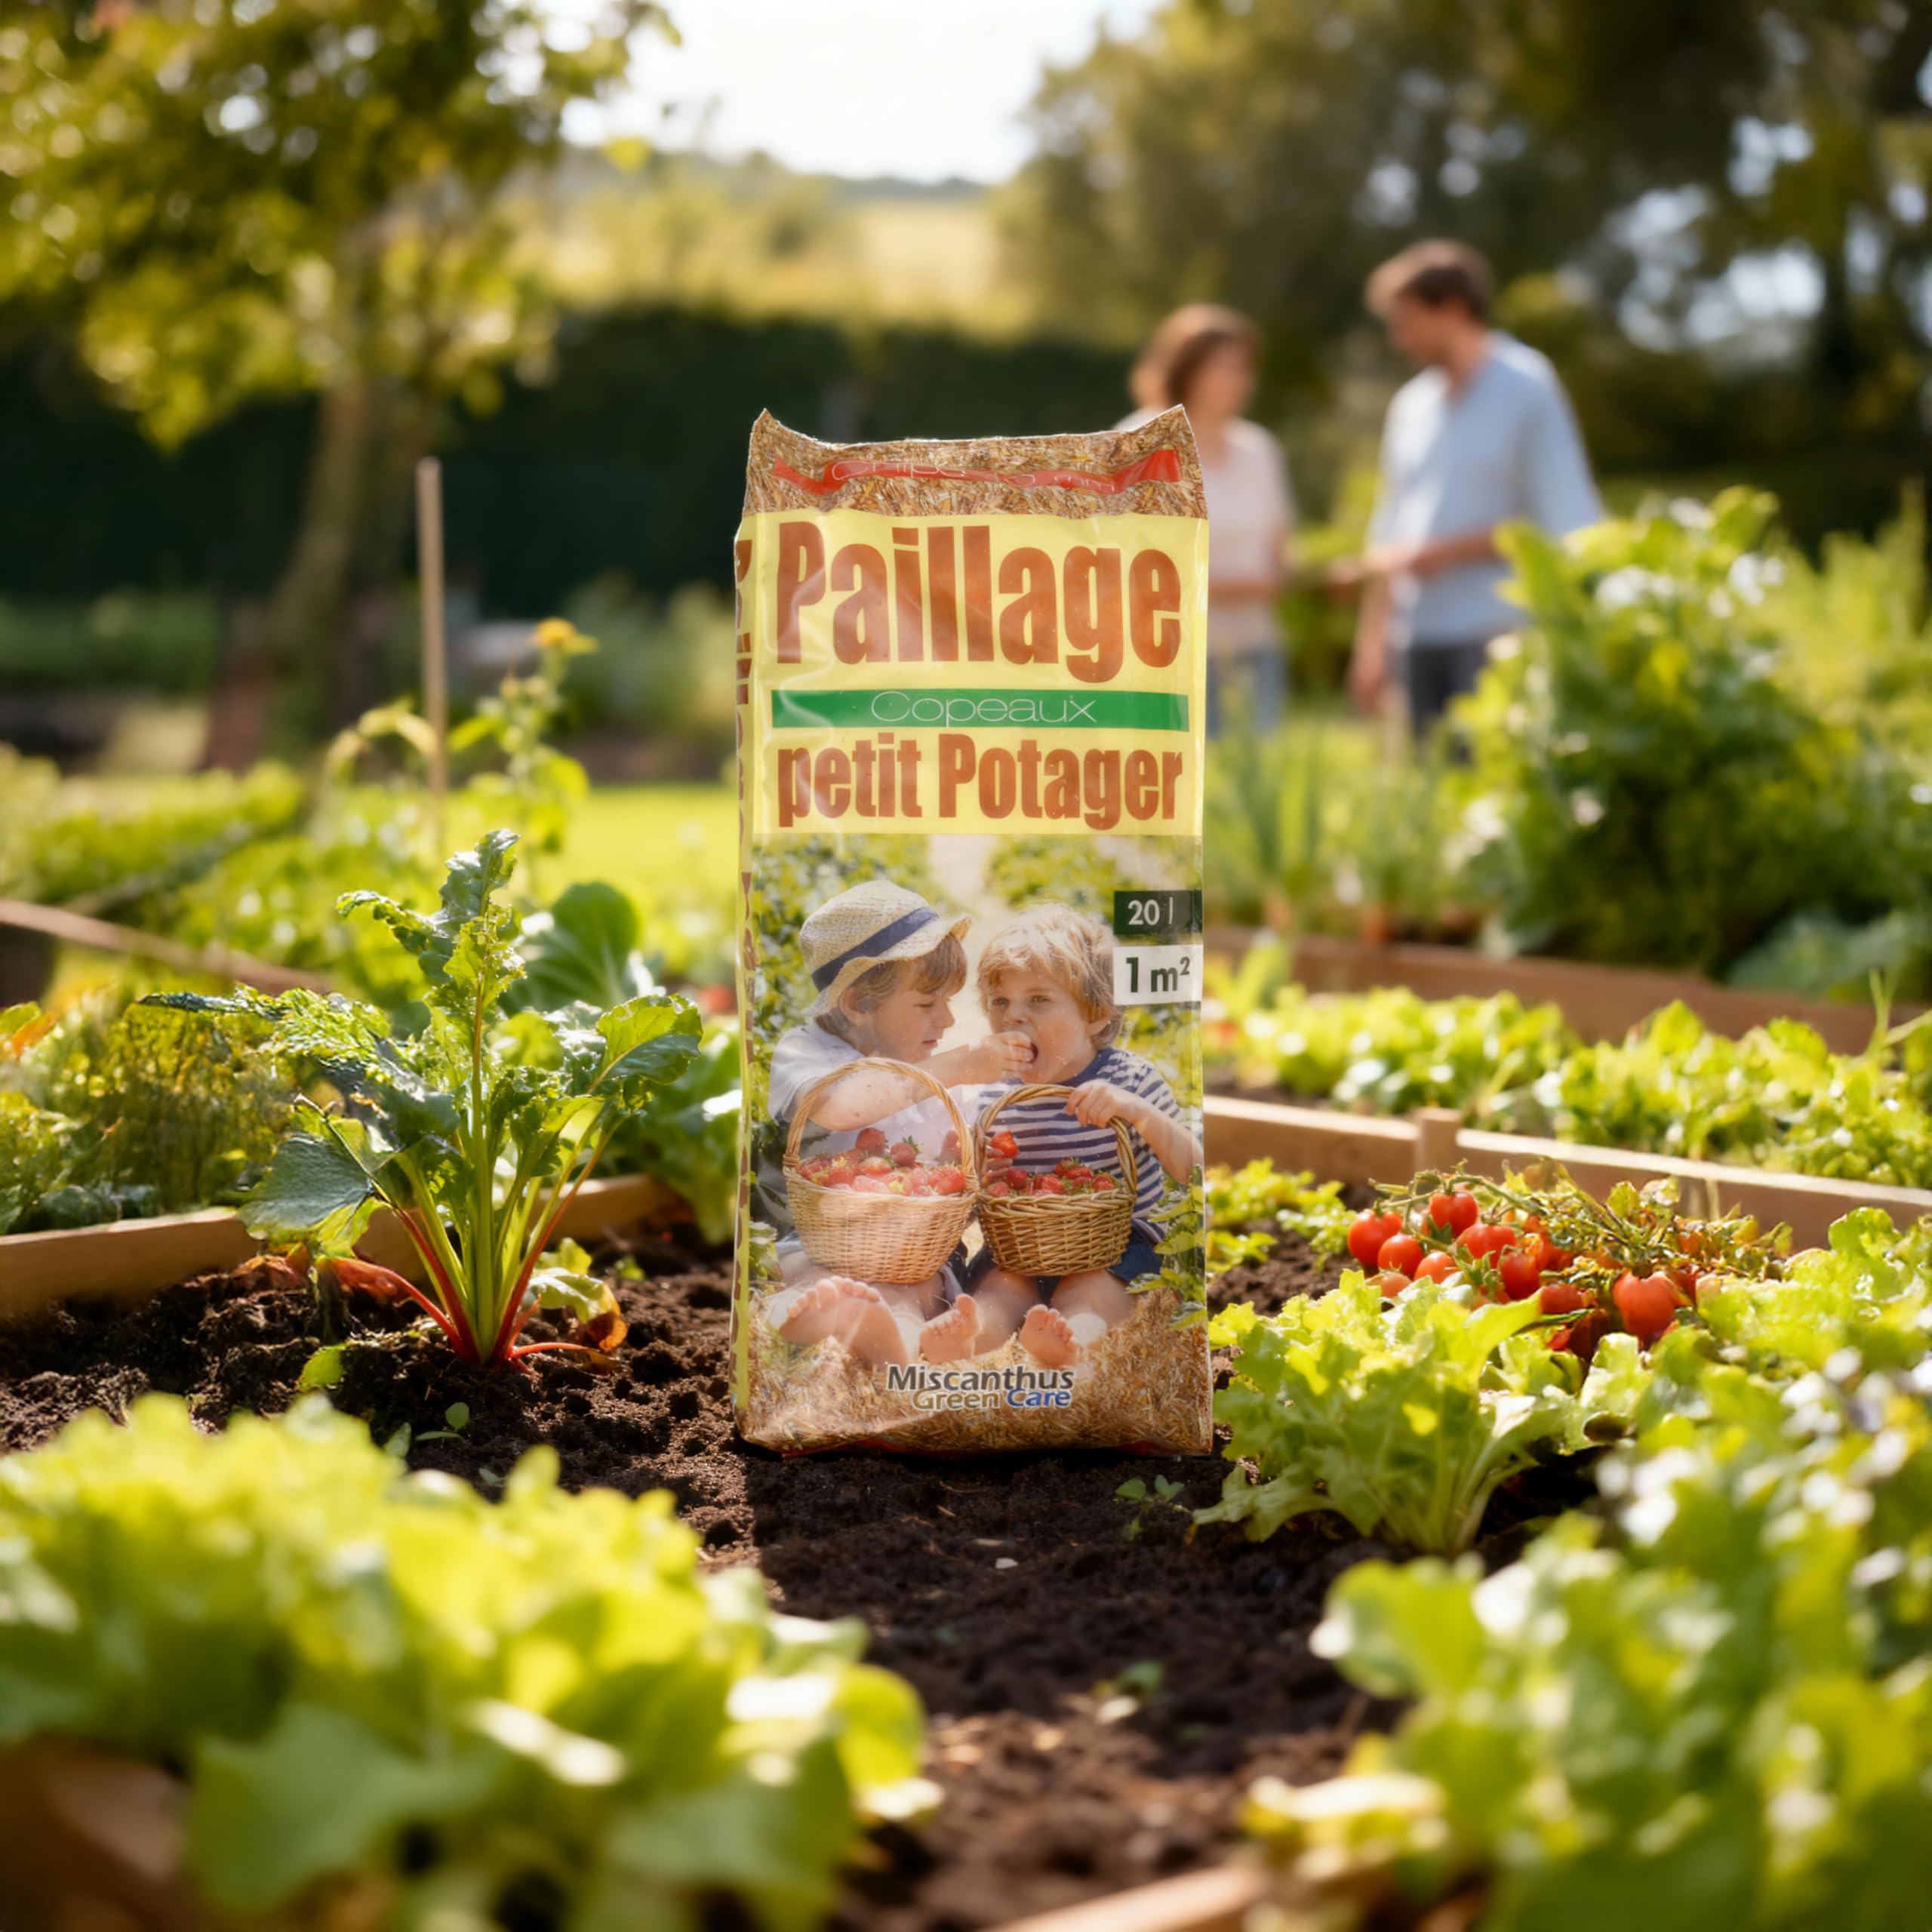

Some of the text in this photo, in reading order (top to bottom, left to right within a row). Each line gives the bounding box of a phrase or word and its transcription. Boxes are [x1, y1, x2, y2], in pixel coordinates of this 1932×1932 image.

[777, 521, 1181, 683] Paillage
[871, 691, 1097, 728] Copeaux
[777, 732, 1183, 830] petit Potager
[1128, 899, 1160, 925] 20
[1126, 957, 1139, 993] 1
[888, 1365, 1074, 1391] Miscanthus
[912, 1388, 1071, 1410] Green Care
